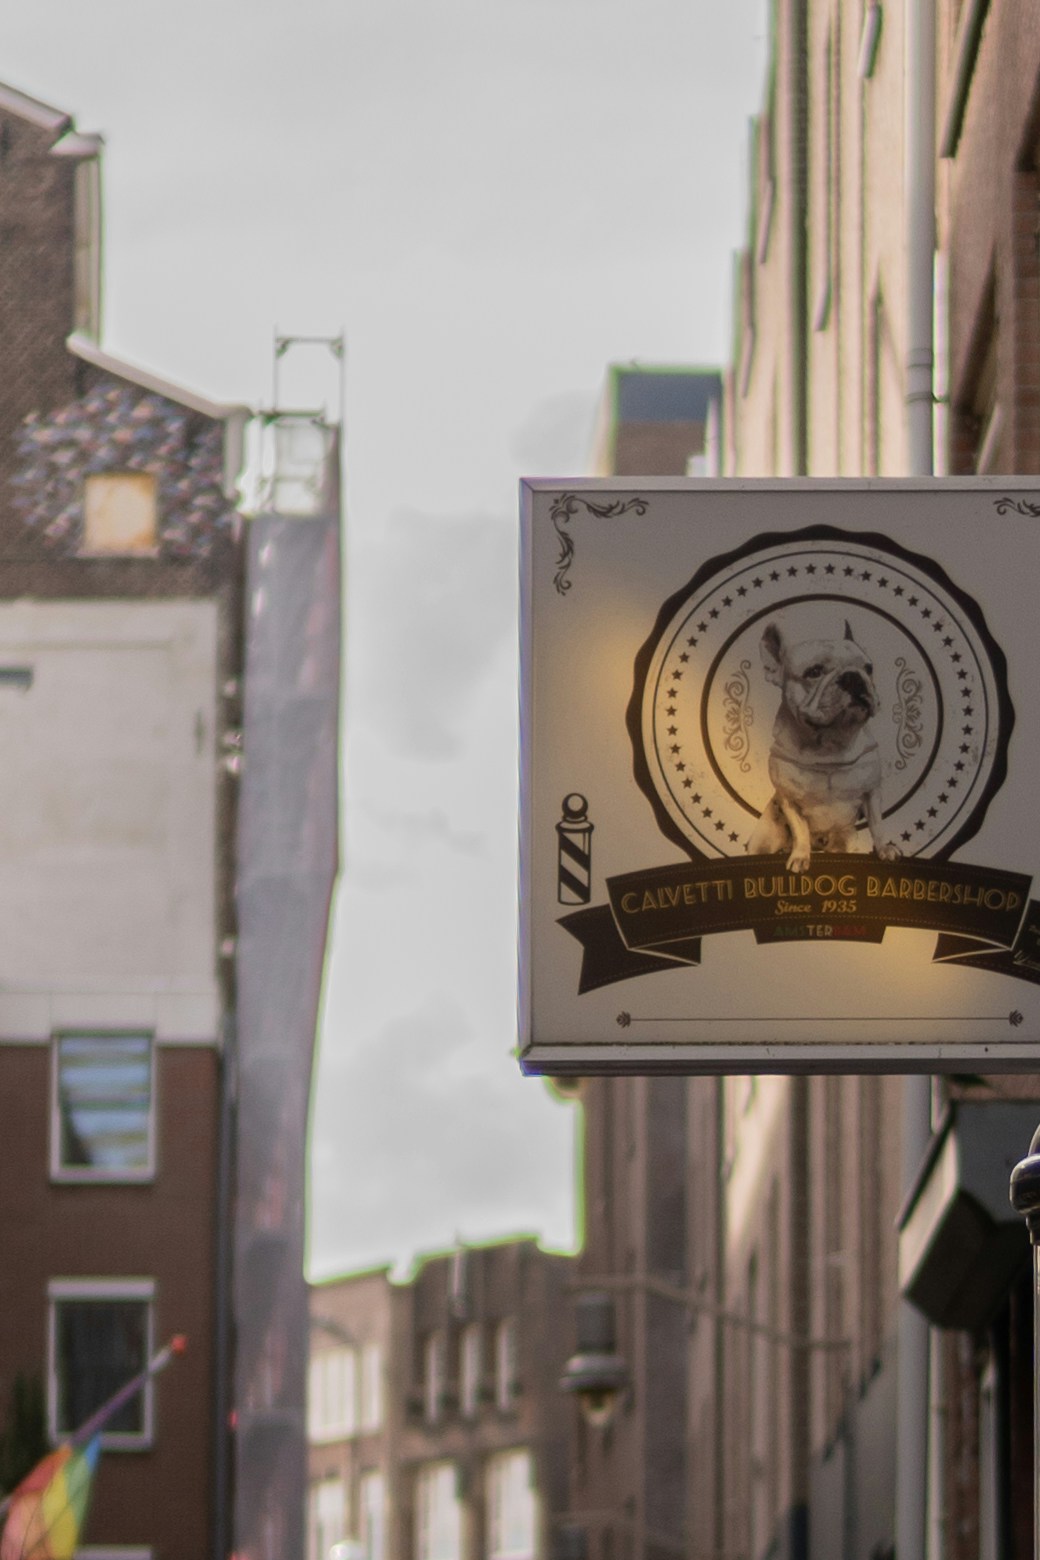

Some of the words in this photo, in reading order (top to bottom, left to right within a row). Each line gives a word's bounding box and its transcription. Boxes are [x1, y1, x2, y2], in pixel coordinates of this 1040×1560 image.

[621, 879, 732, 915] CALVETTI
[744, 875, 858, 899] BULLDOG
[866, 876, 1021, 912] BARBERSHOP
[774, 899, 812, 915] Since
[820, 899, 857, 914] 1935
